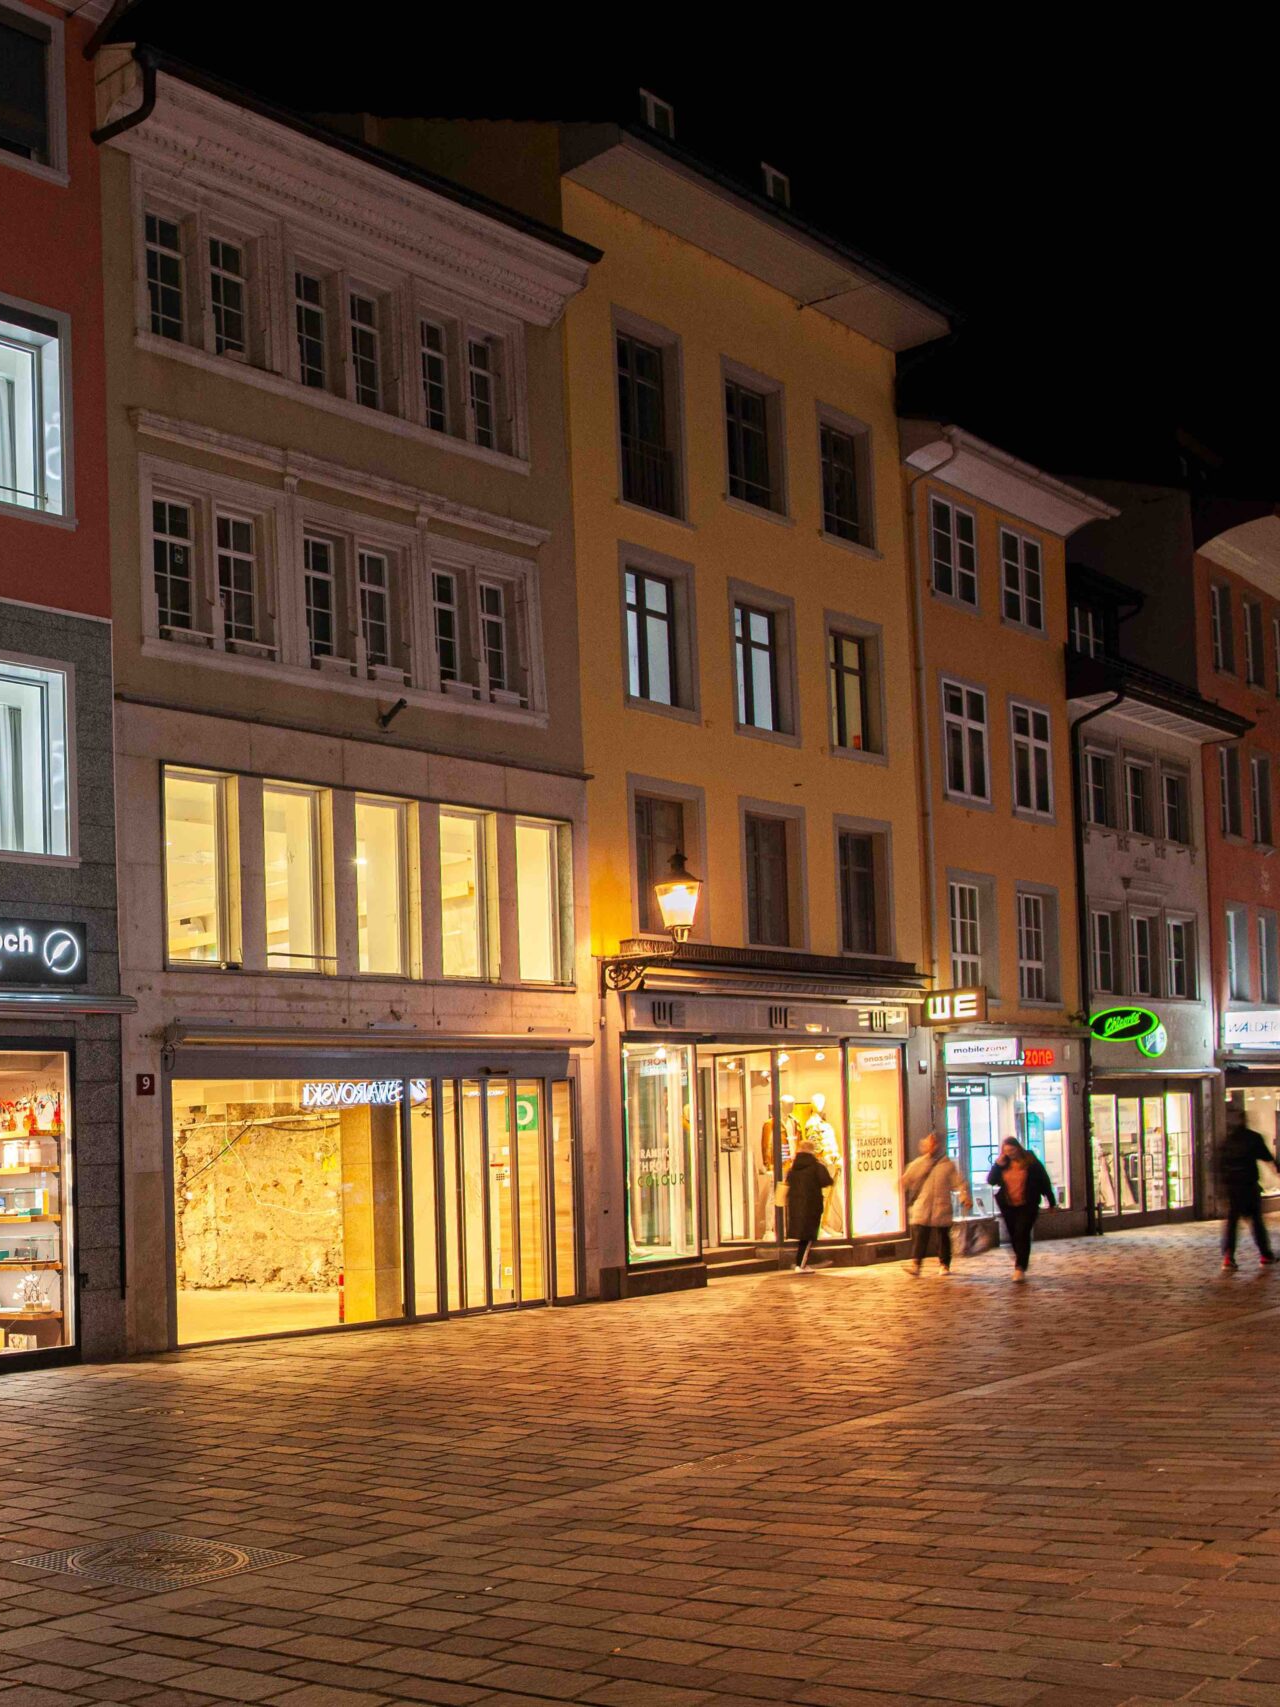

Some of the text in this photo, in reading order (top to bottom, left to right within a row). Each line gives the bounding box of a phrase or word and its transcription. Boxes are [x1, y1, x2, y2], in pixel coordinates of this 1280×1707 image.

[928, 993, 977, 1020] WE
[142, 1076, 150, 1090] 9
[856, 1137, 892, 1147] TRANSFORM
[857, 1148, 892, 1159] THROUGH
[857, 1159, 893, 1172] COLOUR
